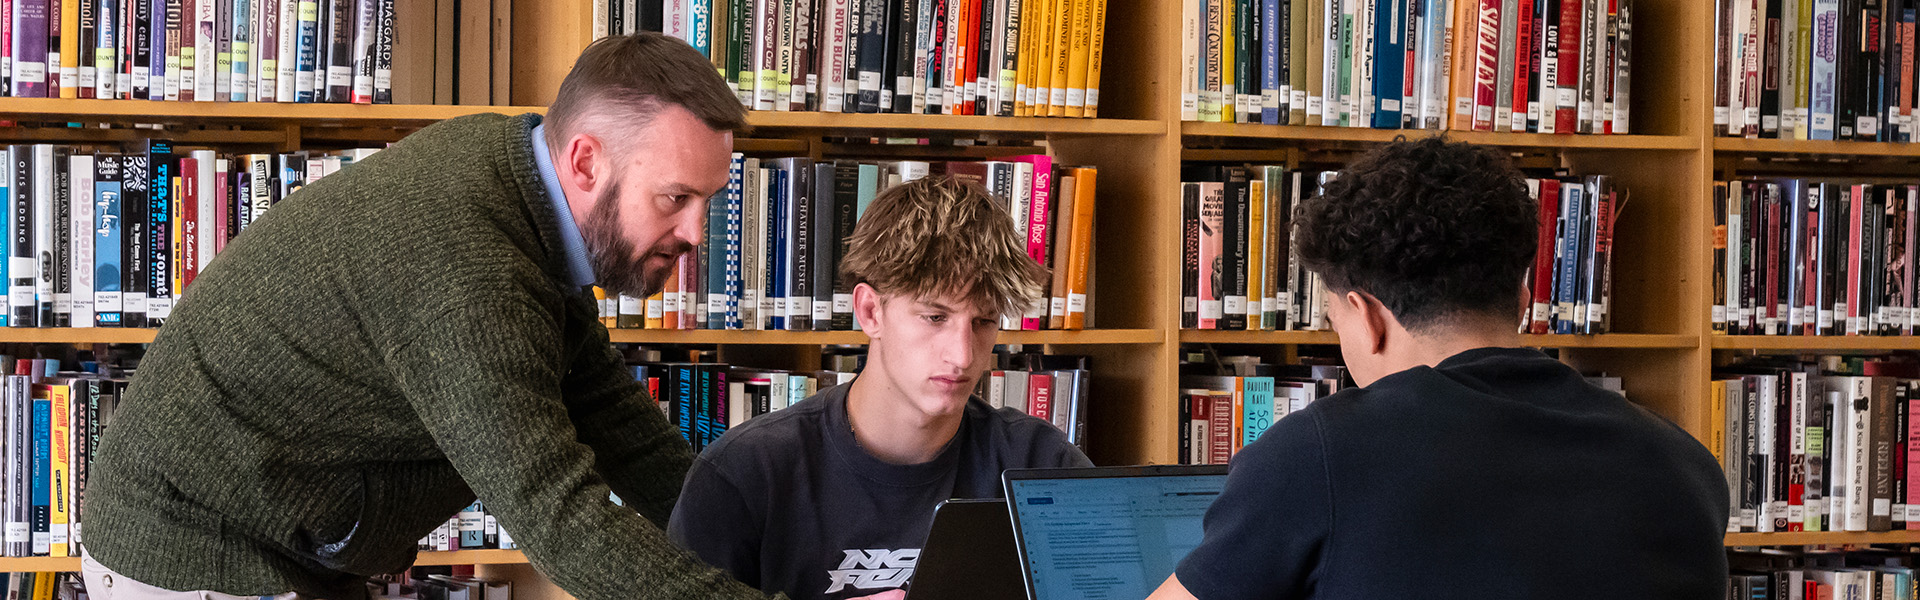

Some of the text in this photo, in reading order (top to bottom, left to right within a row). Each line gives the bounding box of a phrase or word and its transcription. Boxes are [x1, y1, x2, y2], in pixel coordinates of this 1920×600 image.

[250, 20, 258, 44] Cowboys
[333, 11, 343, 44] EARLE
[381, 1, 394, 70] HAGGARD'S
[743, 18, 754, 44] RIGHT
[765, 18, 775, 49] Georgia
[783, 0, 793, 47] BREAKDOWN
[795, 0, 810, 50] PEARLS
[850, 15, 860, 34] ERAS
[862, 15, 873, 34] ERA
[922, 15, 930, 50] REACTIONS
[1407, 15, 1416, 50] YOUR STAGE
[1548, 25, 1558, 48] LOVE
[1816, 14, 1827, 58] CARTOONS
[1825, 11, 1836, 63] HOLLYWOOD
[1869, 16, 1879, 53] ANIME
[1894, 21, 1902, 45] ANIME
[138, 26, 150, 56] cash
[832, 8, 845, 83] RIVER BLUES
[934, 20, 944, 72] AND ROLL
[946, 1, 958, 82] Story The Blues
[1207, 5, 1221, 74] BEST COUNTRY
[1240, 32, 1248, 51] Leisure
[1268, 44, 1275, 54] OF
[1442, 27, 1453, 78] BE OUR GUEST
[1478, 7, 1498, 91] SHELLEY
[1531, 18, 1543, 73] RAISING CAIN
[1747, 37, 1758, 72] CINEMA
[1902, 26, 1913, 74] ANIME
[1057, 49, 1067, 75] MUSIC
[1092, 50, 1100, 73] MUSIC
[1546, 63, 1556, 90] THEFT
[1740, 50, 1748, 80] HAUNTED
[60, 172, 68, 187] BOB
[97, 161, 120, 169] Music
[98, 167, 119, 175] Guide
[254, 159, 269, 198] SOMEBODY
[18, 161, 26, 244] OTIS REDDING
[60, 188, 68, 217] DYLAN,
[240, 186, 249, 203] RAP
[1032, 172, 1050, 244] San Antonio Rose
[60, 218, 68, 241] BRUCE
[97, 190, 119, 238] hip-hop
[133, 223, 141, 231] The
[1595, 201, 1609, 252] ROCK FILM
[1863, 193, 1873, 260] SHOWDOWN
[79, 177, 92, 288] Bob Marley
[157, 223, 165, 250] THE
[186, 220, 195, 271] The Motherlode
[797, 196, 808, 291] CHAMBER MUSIC
[1235, 187, 1246, 295] The Documentary Tradition
[133, 245, 141, 260] Comes
[133, 259, 141, 271] First
[100, 313, 120, 322] AMG
[702, 371, 710, 380] THE
[717, 371, 726, 381] THE
[1247, 382, 1271, 392] PAULINE
[1857, 380, 1865, 396] Kael
[679, 368, 691, 433] THE ENCYCLOPEDIA
[760, 395, 768, 412] DUDLEY
[1036, 387, 1048, 416] MOSC
[1252, 394, 1267, 405] KAEL
[40, 402, 48, 460] MIDNIGHT RIDERS
[54, 393, 68, 465] FALLOPIAN RHAPSODY
[90, 384, 100, 457] 12 Days the Road
[697, 412, 710, 435] JAZZ
[1214, 401, 1230, 437] FOREIGN
[1746, 392, 1756, 456] RECONSTRUCTING
[1183, 440, 1189, 448] ON
[1854, 465, 1863, 484] Bang
[1877, 441, 1889, 494] REELING
[1853, 485, 1862, 505] Bang
